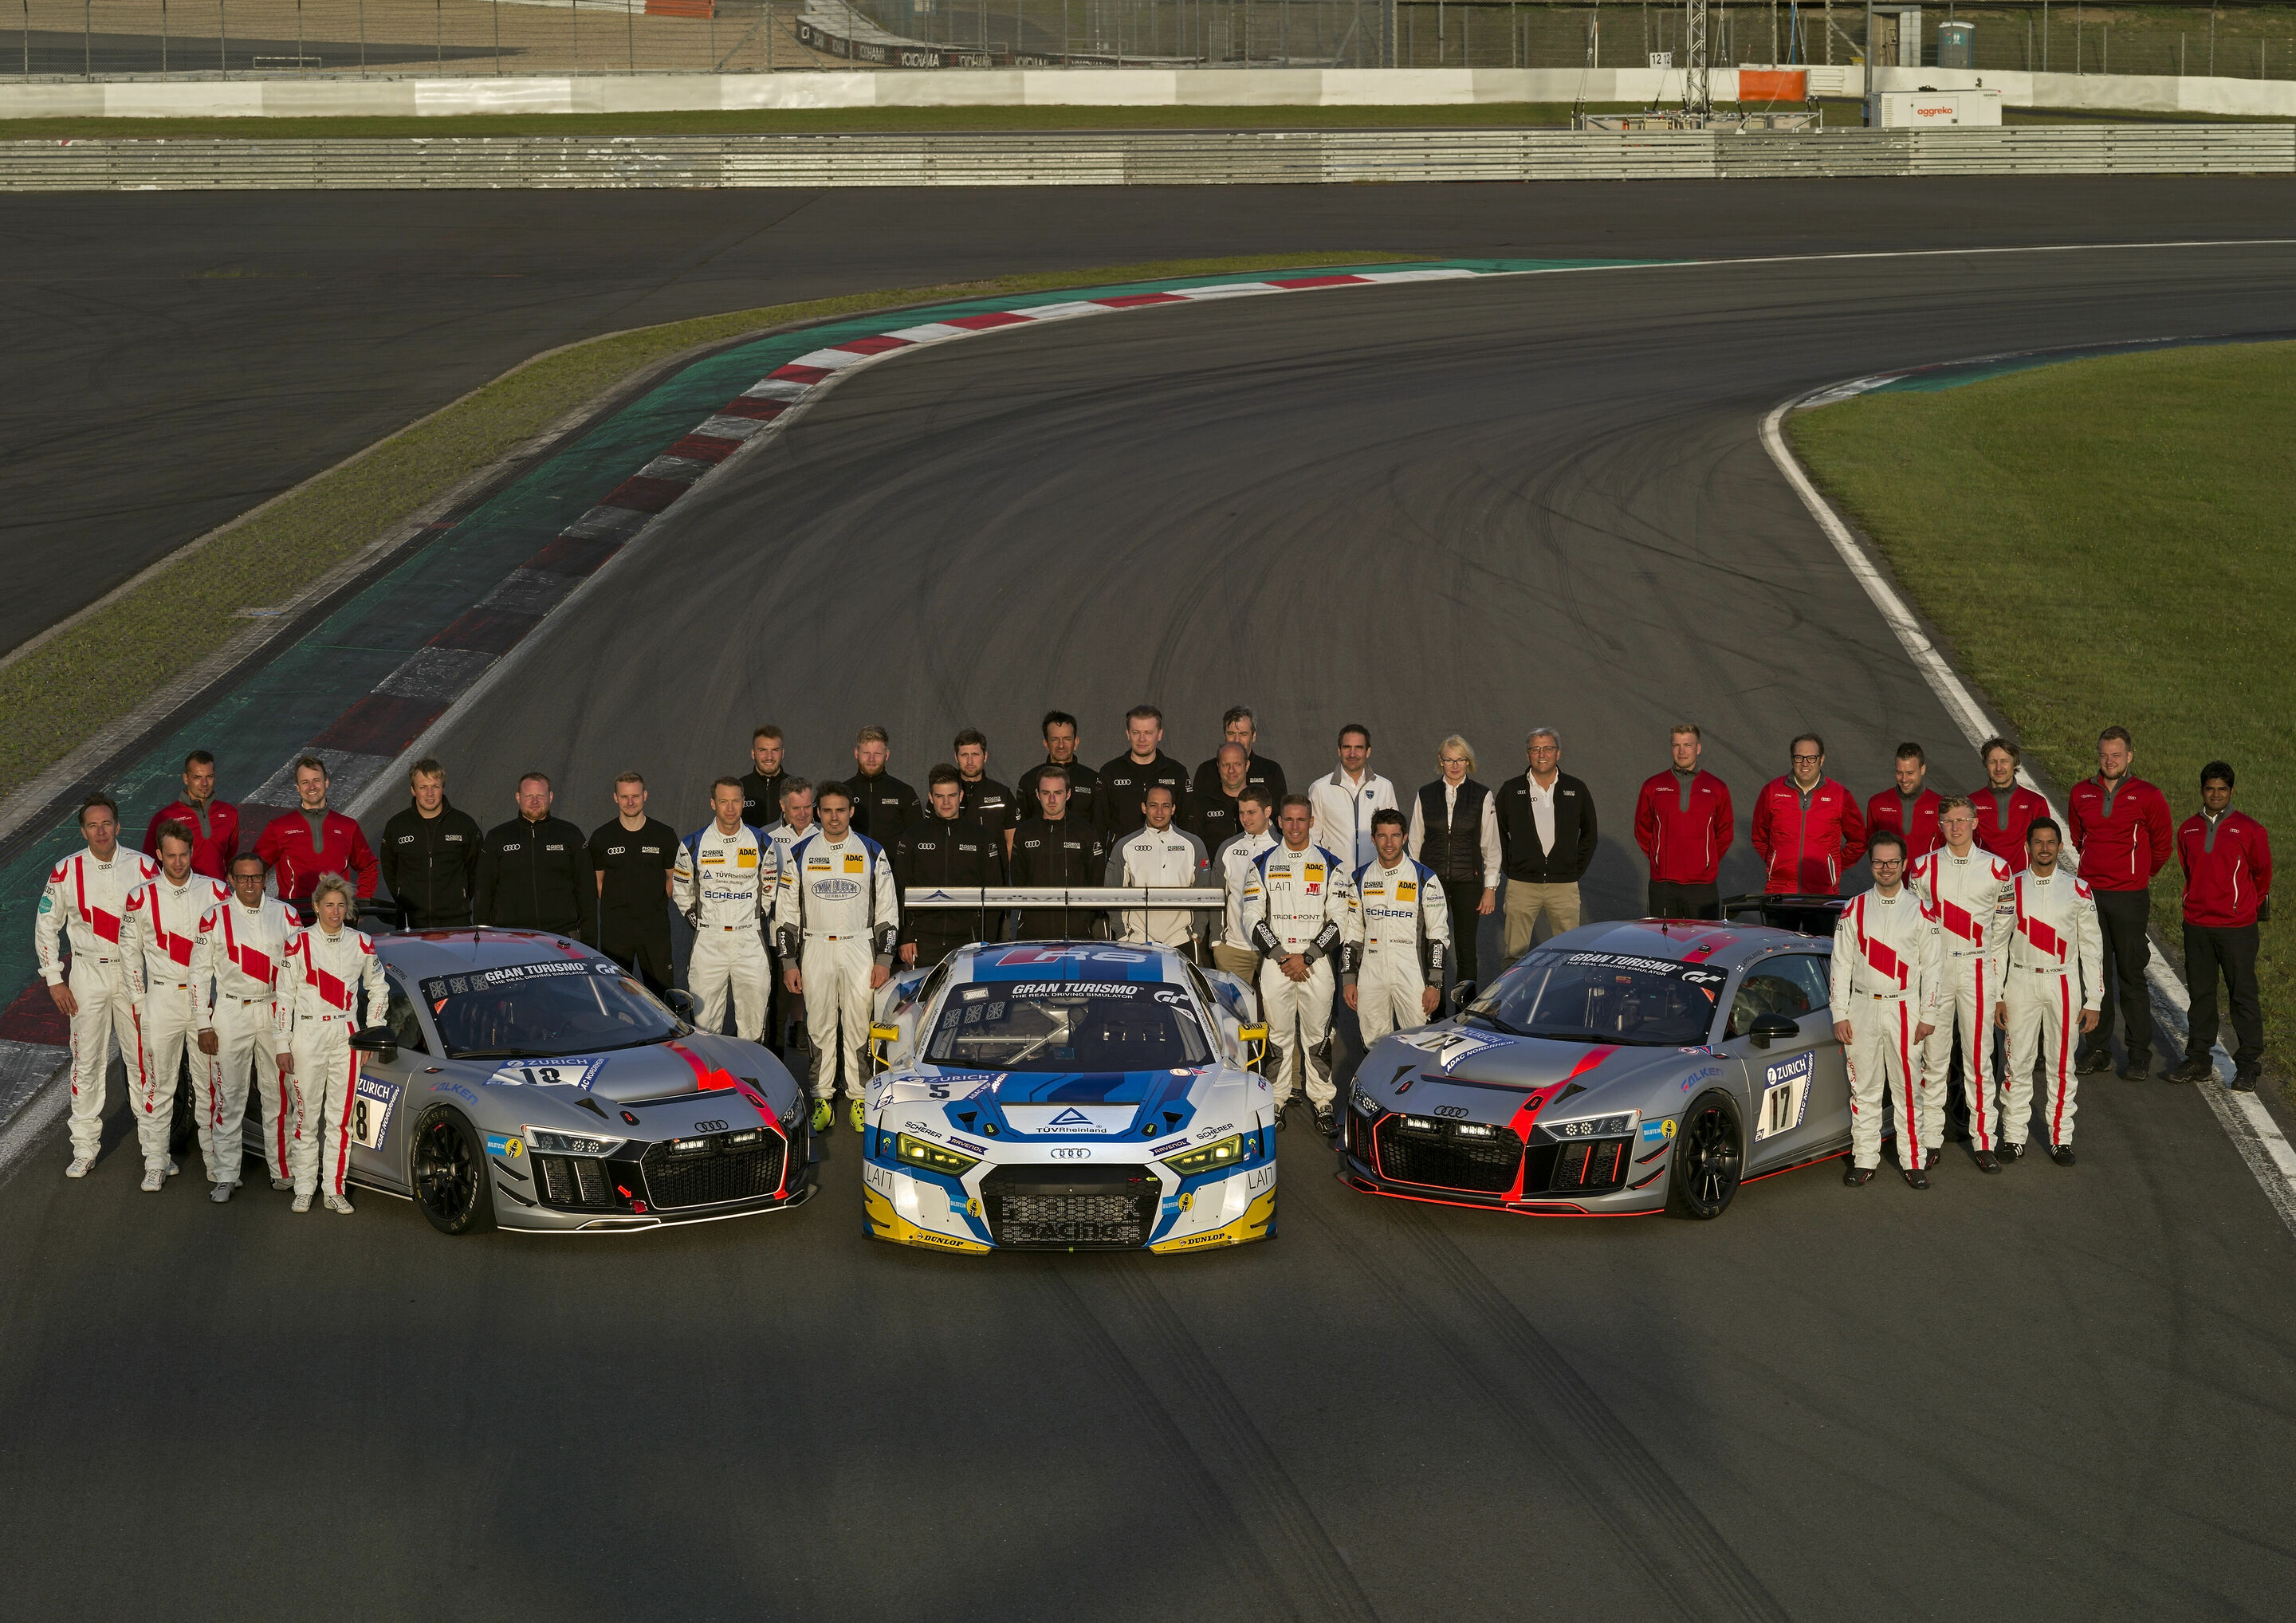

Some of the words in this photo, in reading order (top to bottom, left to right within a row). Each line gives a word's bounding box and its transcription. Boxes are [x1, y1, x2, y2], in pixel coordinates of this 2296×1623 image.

[1652, 53, 1661, 65] 12
[1917, 105, 1953, 117] aggreko
[705, 890, 753, 900] SCHERER
[814, 880, 831, 894] TWIN
[832, 879, 858, 894] BUSCH
[1366, 908, 1413, 918] SCHERER
[1569, 953, 1614, 963] GRAN
[1610, 955, 1677, 973] TURISMO
[1626, 966, 1667, 977] SIMULATOR
[485, 966, 525, 982] GRAN
[524, 962, 584, 975] TURISMO
[1012, 983, 1060, 995] GRAN
[1064, 983, 1138, 995] TURISMO
[527, 1058, 589, 1067] ZURICH
[1447, 1053, 1465, 1072] ADAC
[1466, 1040, 1515, 1056] NORDRHEIN
[519, 1067, 563, 1085] 18
[1776, 1058, 1807, 1080] ZURICH
[1804, 1052, 1814, 1102] NORDRHEIN
[357, 1078, 391, 1100] ZURICH
[1680, 1067, 1724, 1094] FALKEN
[293, 1079, 302, 1106] Sport
[929, 1083, 950, 1099] 5
[1771, 1085, 1791, 1132] 17
[356, 1099, 368, 1142] 8
[377, 1128, 387, 1152] ADAC
[382, 1086, 400, 1129] NORDRHEIN
[904, 1120, 943, 1139] SCHERER
[1196, 1122, 1235, 1140] SCHERER
[950, 1138, 984, 1153] RAVENOL
[1154, 1140, 1187, 1154] RAVENOL
[949, 1200, 966, 1208] BILSTEIN
[923, 1235, 965, 1247] DUNLOP
[1187, 1232, 1225, 1245] DUNLOP
